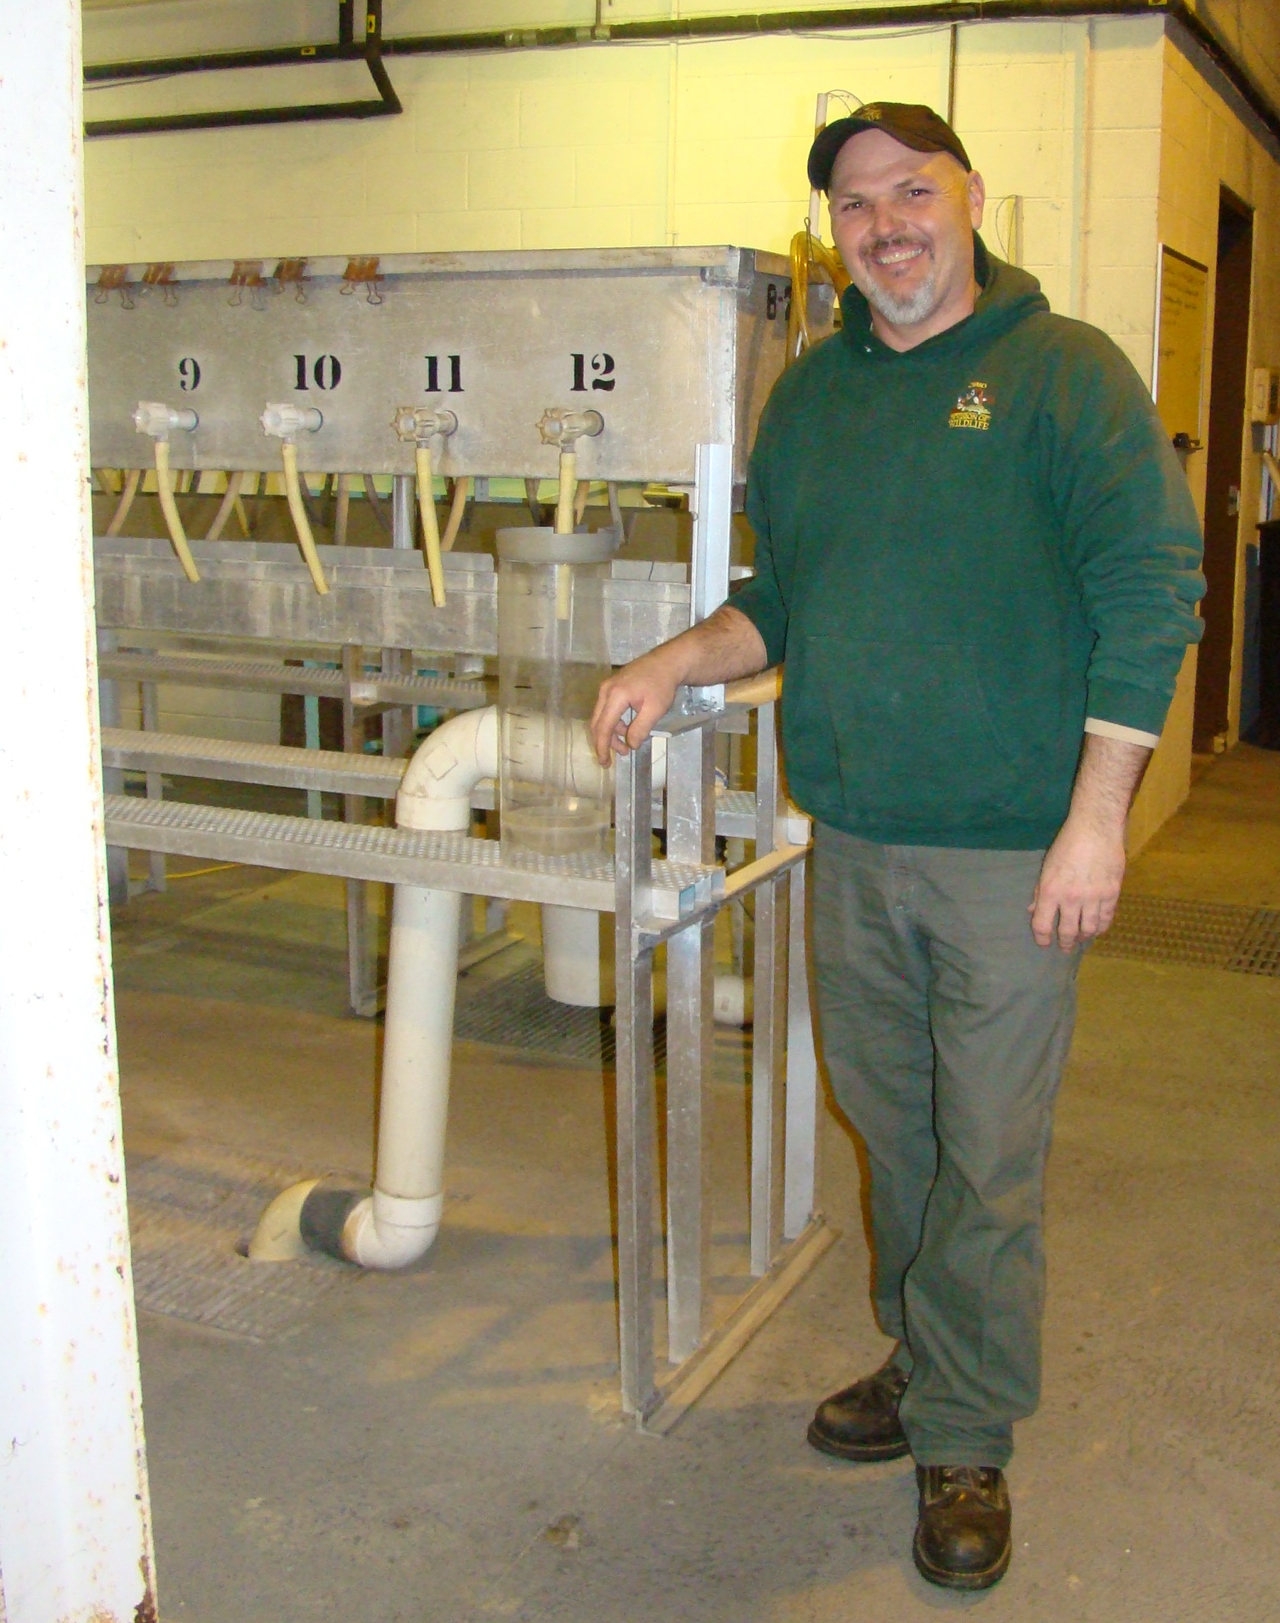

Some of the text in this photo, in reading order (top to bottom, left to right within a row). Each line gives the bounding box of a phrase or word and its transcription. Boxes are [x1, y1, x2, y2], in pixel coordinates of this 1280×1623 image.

[179, 358, 201, 391] 9
[294, 354, 342, 391] 10
[424, 355, 465, 393] 11
[570, 353, 616, 392] 12
[948, 419, 990, 431] WILDLIFE
